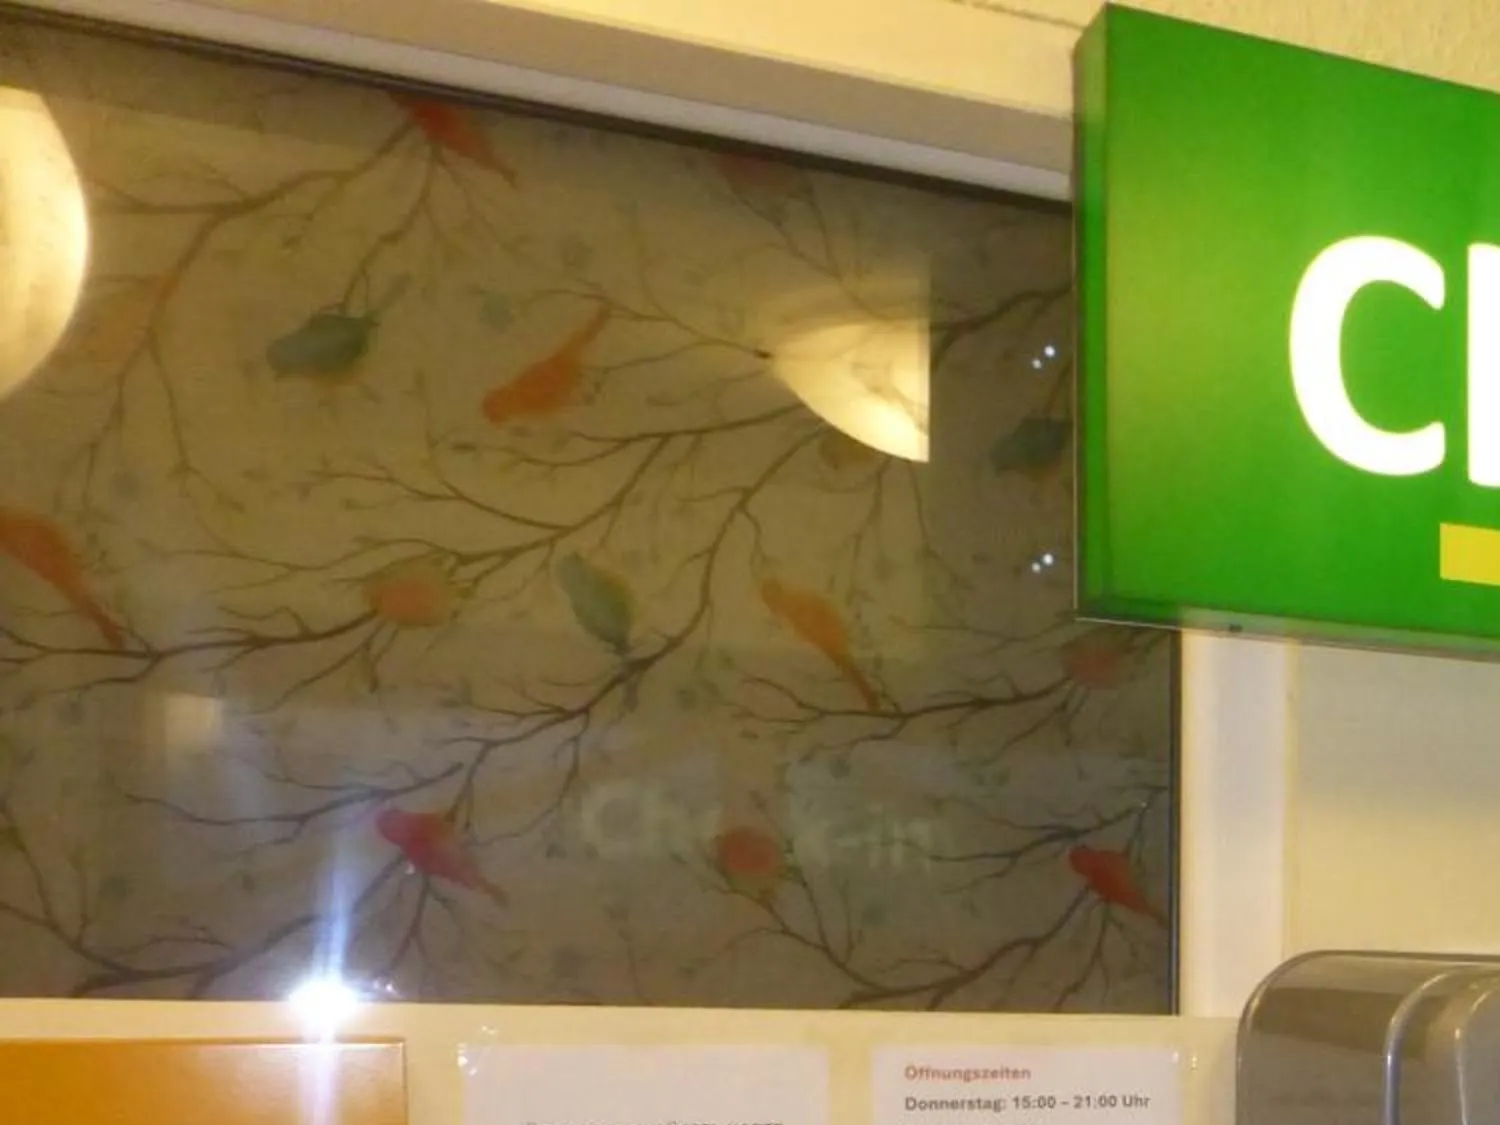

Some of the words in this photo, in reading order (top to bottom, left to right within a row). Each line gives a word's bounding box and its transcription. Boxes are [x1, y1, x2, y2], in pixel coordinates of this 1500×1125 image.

[905, 1096, 1006, 1112] Donnerstag:
[1012, 1095, 1057, 1109] 15:00
[1073, 1095, 1118, 1109] 21:00
[1123, 1094, 1151, 1108] Uhr
